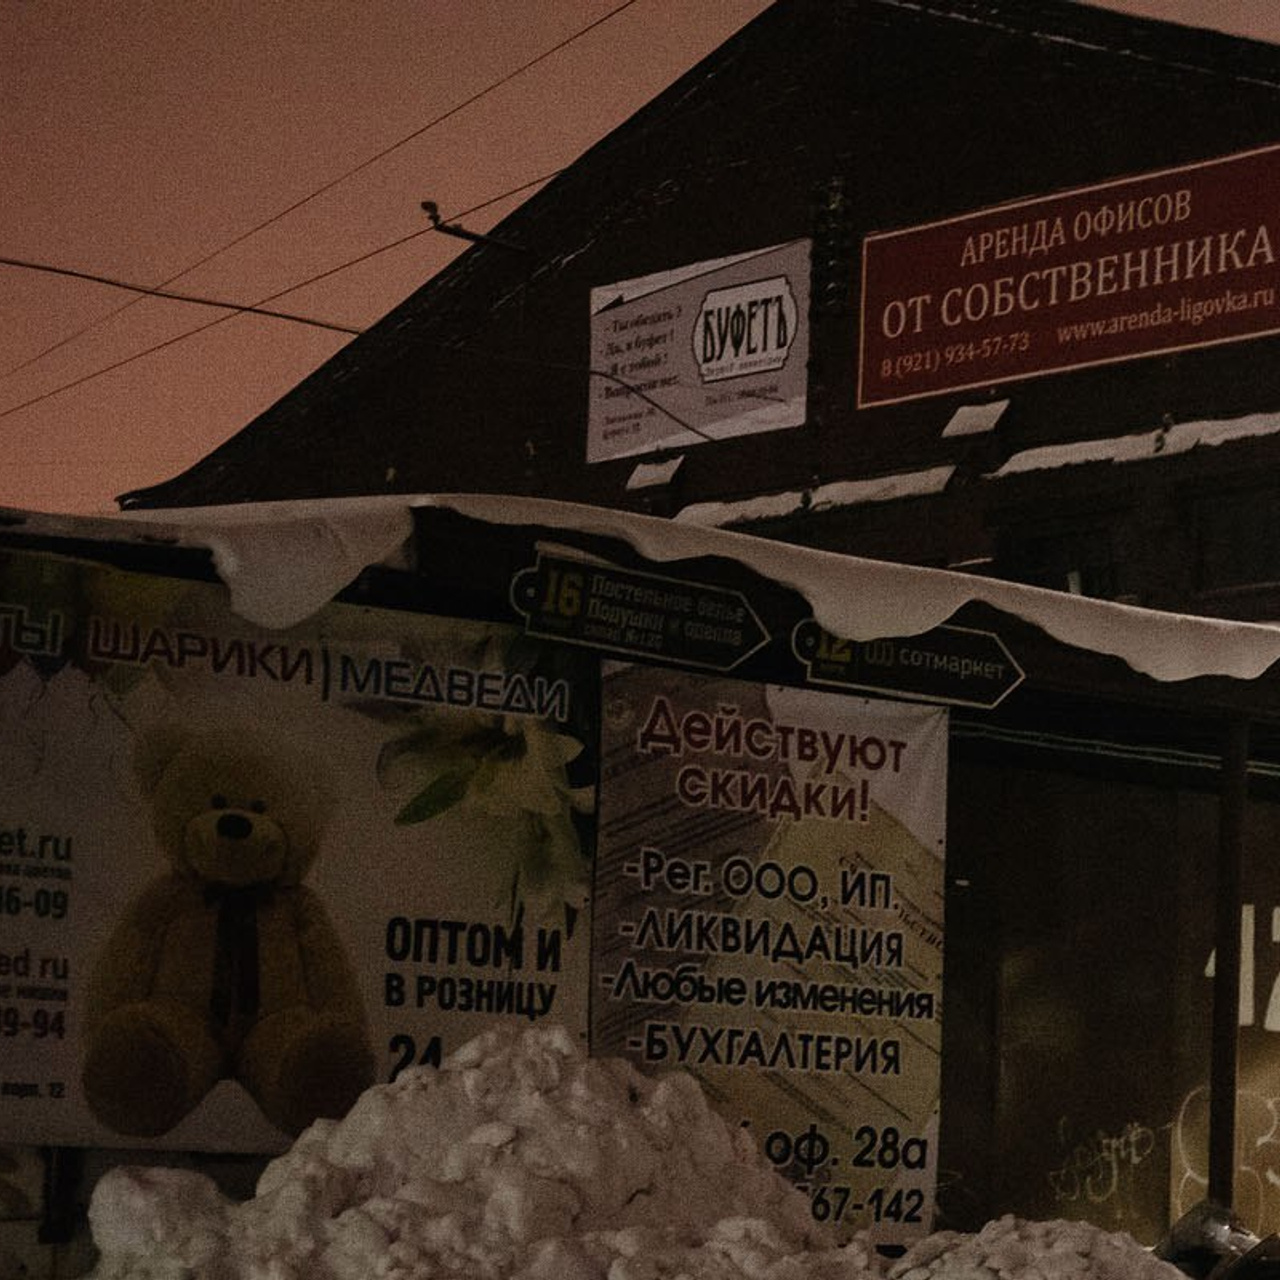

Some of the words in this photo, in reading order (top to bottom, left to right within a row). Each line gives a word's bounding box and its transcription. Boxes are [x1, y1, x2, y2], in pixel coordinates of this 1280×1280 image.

[961, 217, 1066, 268] АРЕНДА
[1073, 190, 1192, 240] ОФИСОВ
[881, 295, 932, 339] ОТ
[940, 224, 1277, 325] СОБСТВЕННИКА
[702, 296, 788, 364] БУФЕТЪ
[1057, 288, 1275, 344] www.arenda-ligovka.ru
[542, 567, 584, 617] 16
[90, 619, 314, 684] ШАРИКИ
[341, 656, 570, 721] МЕДВЕДИ
[899, 647, 1005, 681] сотмаркет
[639, 697, 907, 775] Действуют
[626, 850, 710, 893] -Рег.
[723, 858, 828, 909] ООО,
[840, 870, 898, 911] ИП.
[385, 916, 524, 970] ОПТОМ
[537, 928, 561, 973] И
[622, 910, 903, 969] -ЛИКВИДАЦИЯ
[385, 973, 404, 1007] В
[416, 975, 557, 1021] РОЗНИЦУ
[601, 960, 749, 1006] -Любые
[754, 980, 934, 1020] изменения
[630, 1023, 902, 1076] -БУХГАЛТЕРИЯ
[765, 1123, 840, 1175] оф.
[796, 1185, 924, 1222] 67-142
